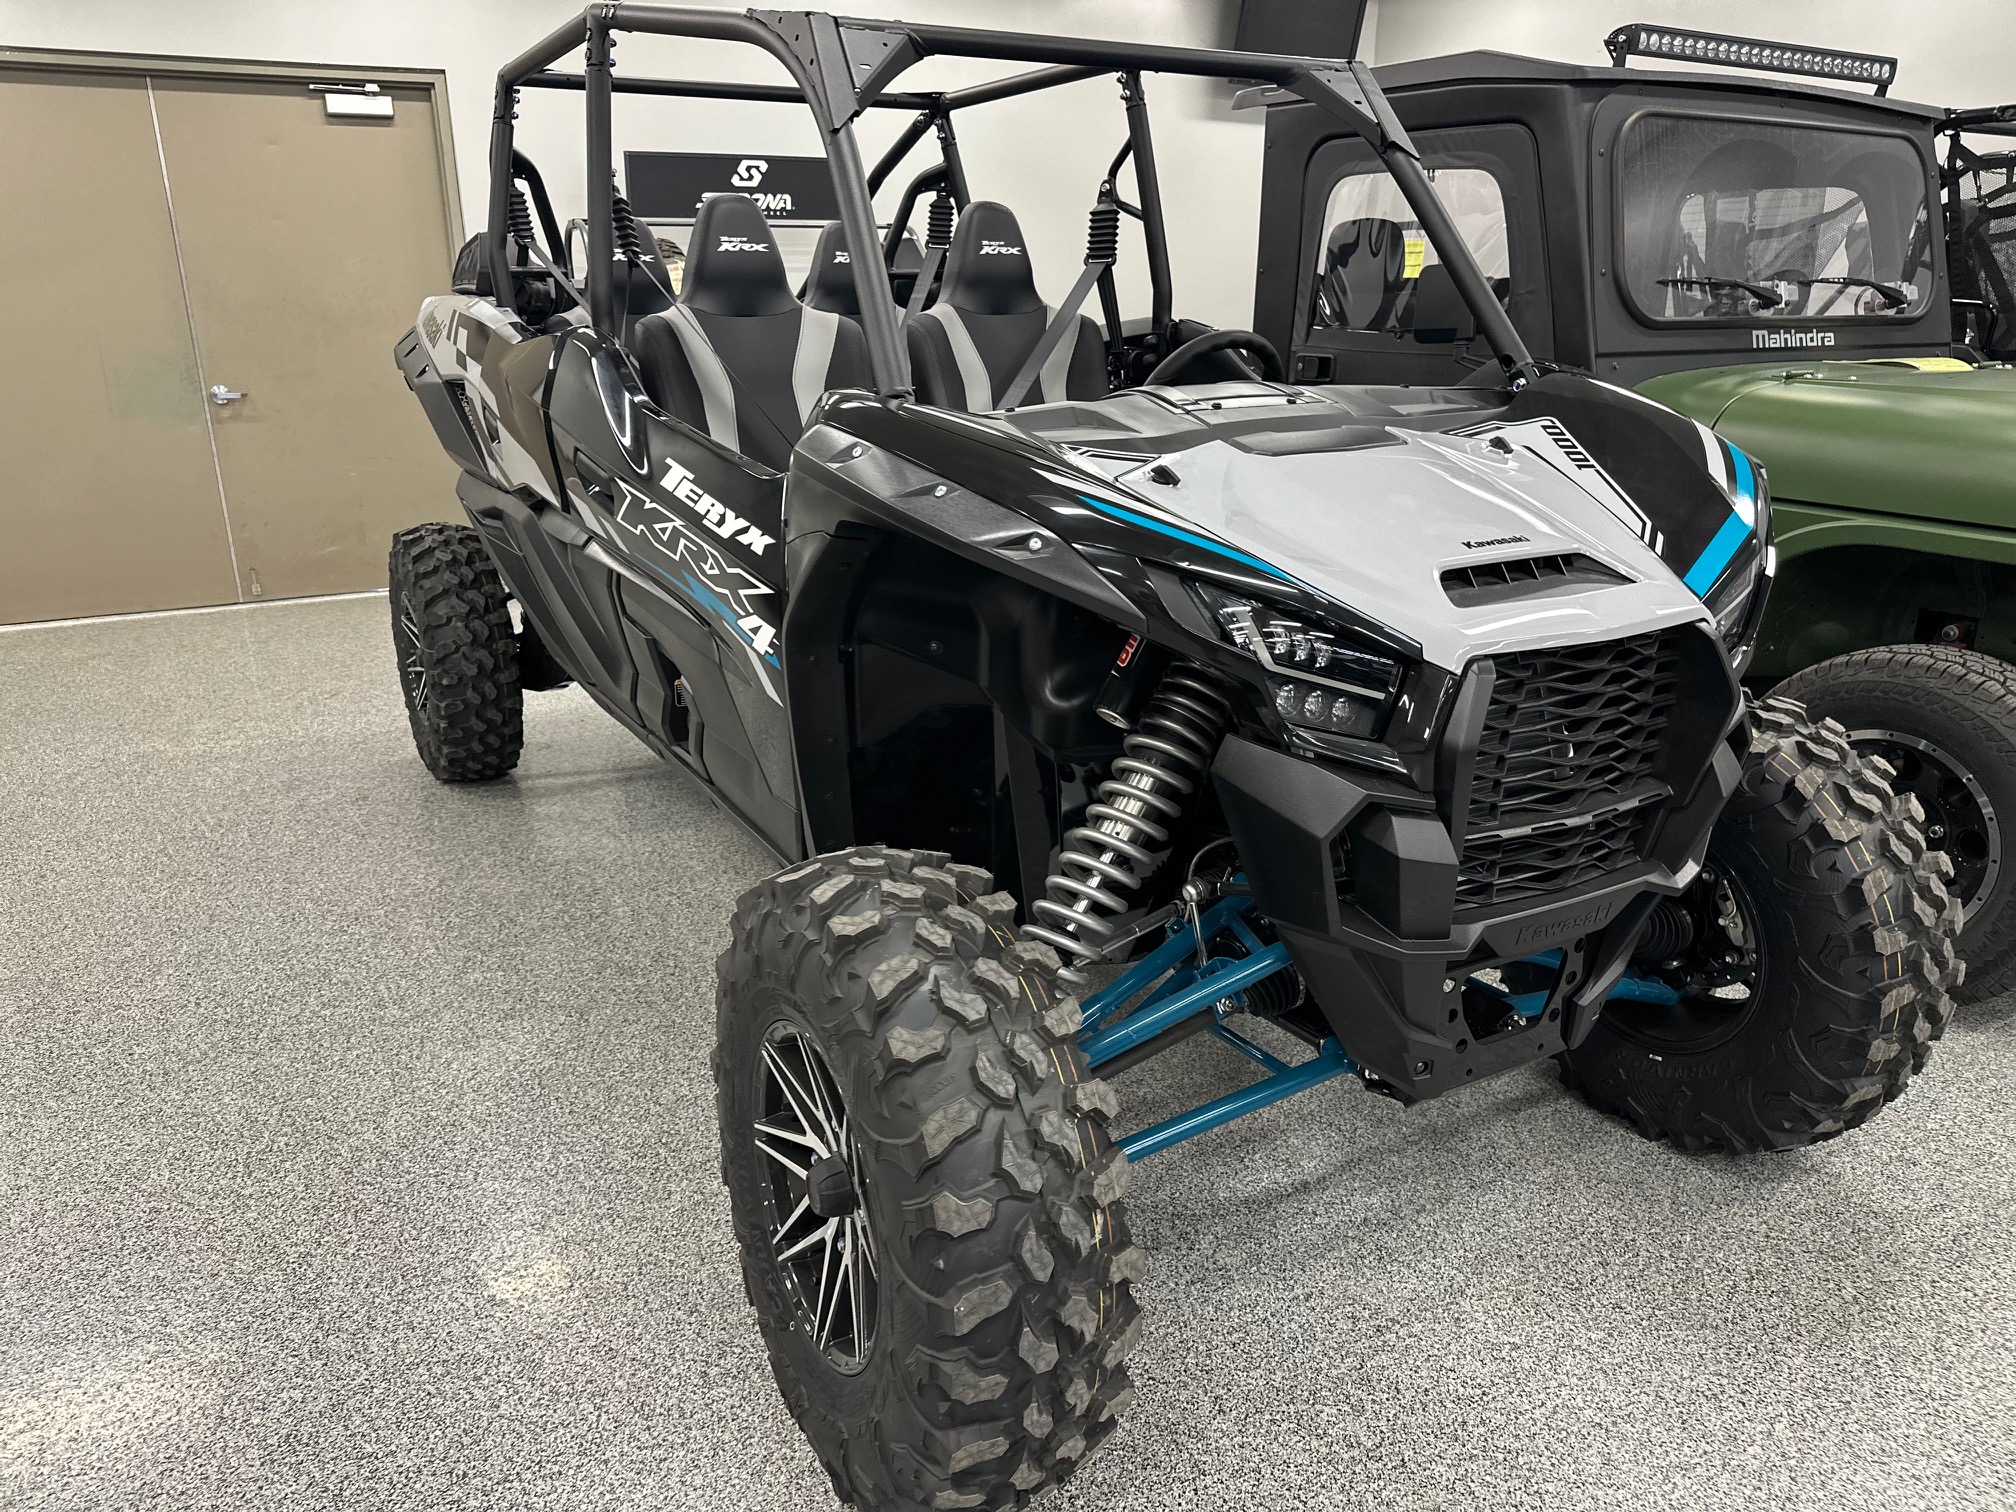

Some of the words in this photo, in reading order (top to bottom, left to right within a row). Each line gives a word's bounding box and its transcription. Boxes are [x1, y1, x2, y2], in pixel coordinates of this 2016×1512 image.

[717, 241, 770, 252] KRX
[978, 245, 1023, 255] KRX
[612, 252, 655, 263] KX
[1751, 328, 1836, 349] Mahindra
[659, 456, 777, 556] TERYX
[1461, 534, 1531, 550] Kawasaki
[613, 477, 776, 616] KRX
[736, 614, 780, 656] 4
[1515, 902, 1614, 946] Kawasaki
